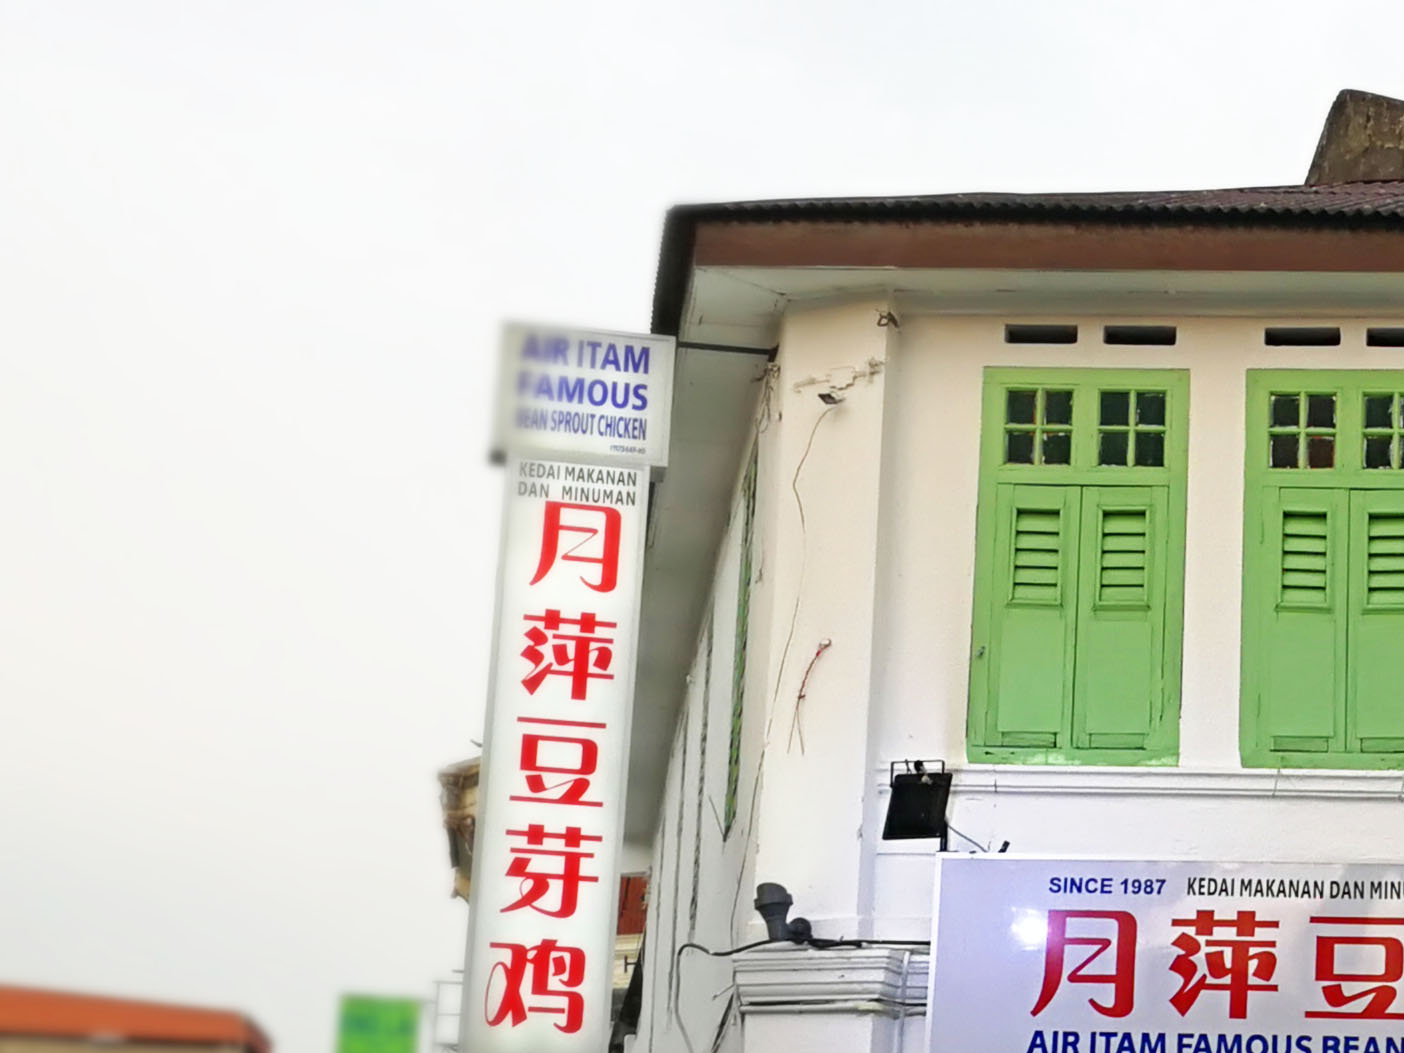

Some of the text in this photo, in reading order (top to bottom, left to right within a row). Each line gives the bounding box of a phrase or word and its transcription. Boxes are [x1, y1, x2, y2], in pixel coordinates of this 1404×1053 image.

[522, 332, 650, 375] AIR ITAM
[516, 369, 648, 411] FAMOUS
[515, 407, 648, 441] BEAN SPROUT CHICKEN
[520, 461, 637, 487] KEDAI MAKANAN
[518, 481, 637, 507] DAN MINUMAN
[484, 500, 622, 1034] 月萍豆芽鸡
[1049, 877, 1167, 896] SINCE 1987
[1186, 877, 1236, 897] KEDAI
[1240, 878, 1324, 899] MAKANAN
[1329, 880, 1366, 899] DAN
